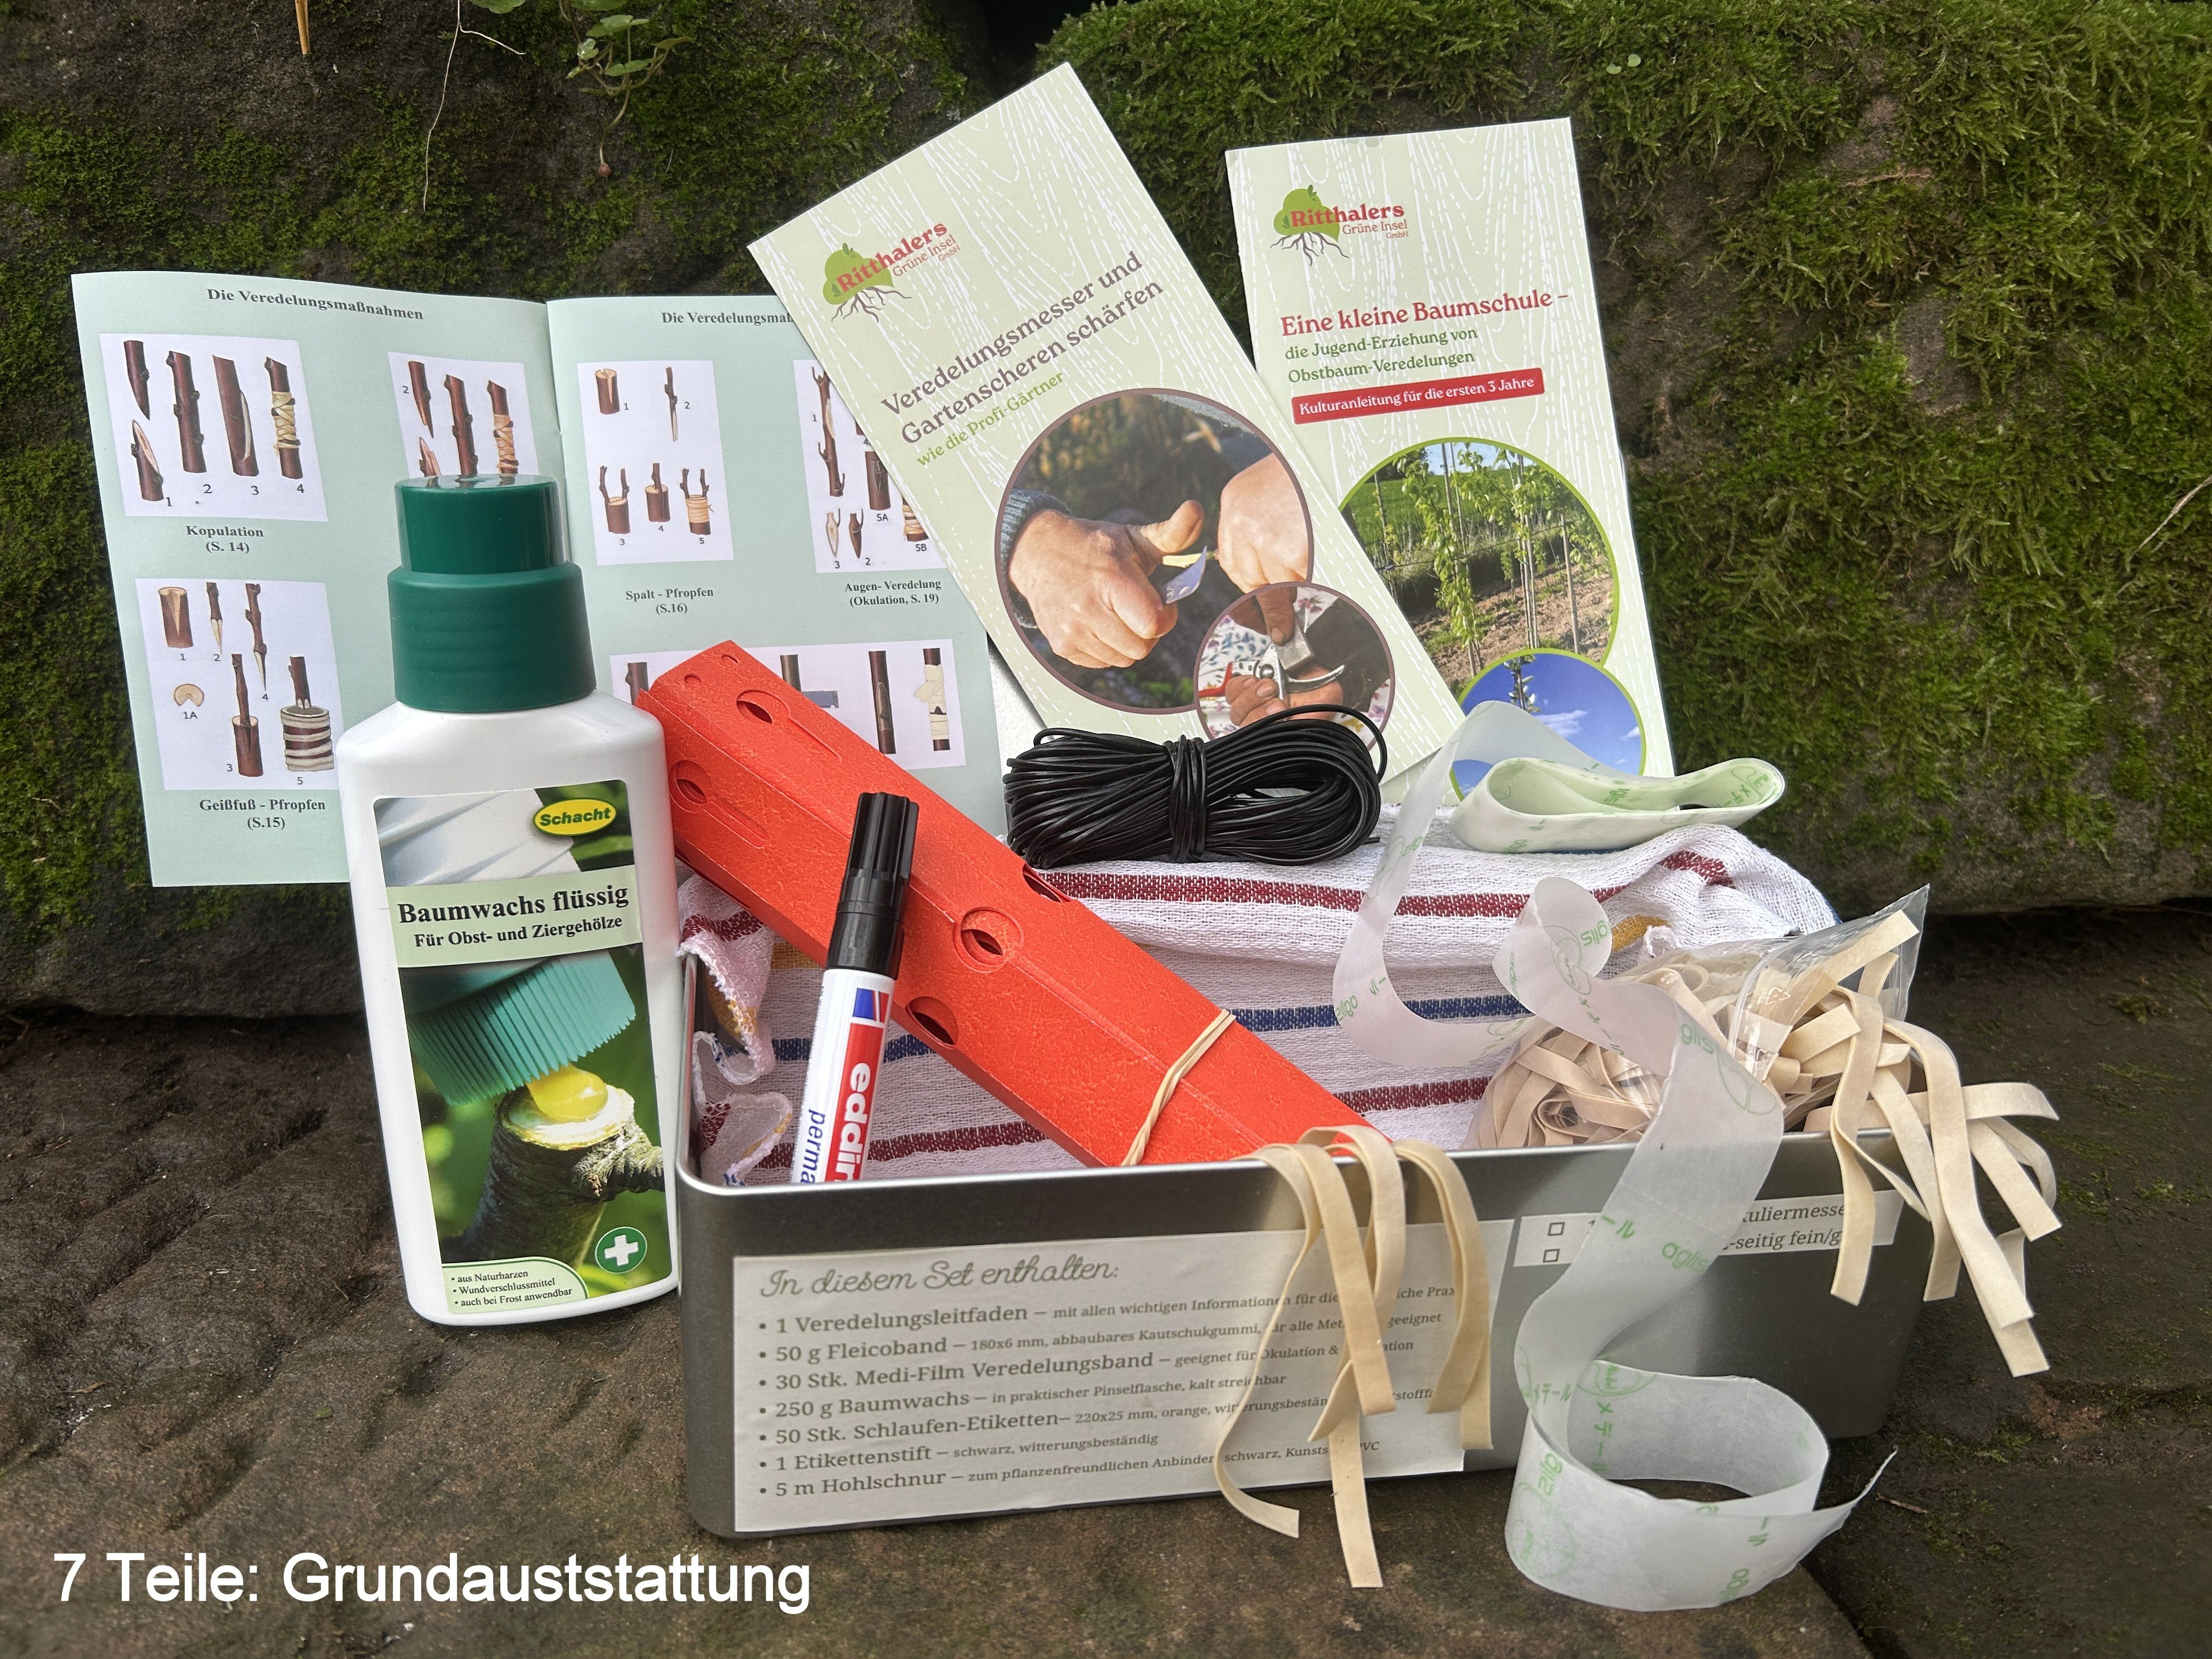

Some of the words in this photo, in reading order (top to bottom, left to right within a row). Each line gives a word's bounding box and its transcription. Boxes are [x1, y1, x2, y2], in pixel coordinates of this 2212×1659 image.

[1290, 204, 1404, 227] Ritthalers
[1342, 222, 1378, 235] Grüne
[1381, 219, 1408, 231] Insel
[1386, 231, 1408, 239] GmbH
[836, 223, 947, 293] Ritthalers
[892, 253, 928, 277] Grüne
[929, 234, 956, 257] Insel
[938, 245, 961, 262] GmbH
[207, 289, 234, 301] Die
[239, 290, 424, 320] Veredelungsmaßnahmen
[1280, 314, 1333, 336] Eine
[1339, 307, 1408, 330] kleine
[1413, 289, 1553, 321] Baumschule
[662, 312, 684, 323] Die
[687, 312, 794, 326] Veredelungsma
[881, 281, 1095, 415] Veredelungsmesser
[1098, 251, 1142, 289] und
[1285, 346, 1308, 360] die
[1311, 331, 1448, 359] Jugend-Erziehung
[1450, 328, 1478, 342] von
[901, 341, 1066, 443] Gartenscheren
[1067, 281, 1164, 347] schärfen
[1288, 351, 1475, 383] Obstbaum-Veredelungen
[1299, 391, 1402, 416] Kulturanleitung
[1403, 389, 1422, 404] für
[1424, 387, 1443, 400] die
[1445, 383, 1485, 398] ersten
[1487, 381, 1496, 393] 3
[1498, 375, 1534, 392] Jahre
[916, 445, 945, 467] wie
[945, 430, 968, 452] die
[966, 371, 1064, 437] Profi-Gärtner
[203, 484, 212, 494] 2
[251, 486, 259, 495] 3
[297, 484, 304, 493] 4
[166, 497, 172, 506] 1
[877, 514, 888, 522] 5A
[186, 525, 264, 538] Kopulation
[206, 541, 224, 553] (S.
[229, 541, 250, 554] 14)
[626, 589, 655, 603] Spalt
[666, 588, 714, 602] Pfropfen
[845, 582, 881, 594] Augen-
[884, 579, 941, 592] Veredelung
[656, 603, 688, 616] (S.16)
[850, 595, 908, 607] (Okulation,
[911, 594, 921, 604] S.
[924, 593, 939, 605] 19)
[183, 712, 198, 720] 1A
[227, 764, 233, 772] 3
[297, 777, 303, 785] 5
[200, 798, 256, 811] Geißfuß
[269, 799, 325, 812] Pfropfen
[247, 817, 285, 830] (S.15)
[540, 807, 611, 827] Schacht
[397, 895, 546, 924] Baumwachs
[552, 885, 629, 911] flüssig
[413, 932, 444, 947] Für
[448, 929, 493, 945] Obst-
[498, 926, 528, 942] und
[532, 916, 623, 939] Ziergehölze
[800, 1109, 826, 1183] perma
[458, 1275, 473, 1283] aus
[475, 1270, 528, 1283] Naturharzen
[760, 1269, 803, 1297] In
[811, 1268, 918, 1294] diesem
[924, 1260, 974, 1289] Set
[981, 1254, 1118, 1285] enthalten:
[459, 1278, 556, 1295] Wundverschlussmittel
[461, 1297, 481, 1307] auch
[484, 1295, 498, 1306] bei
[499, 1294, 522, 1305] Frost
[524, 1288, 573, 1302] anwendbar
[776, 1318, 787, 1333] 1
[795, 1305, 1028, 1333] Veredelungsleitfaden
[1053, 1306, 1077, 1318] mit
[1081, 1305, 1116, 1317] allen
[1120, 1300, 1187, 1316] wichtigen
[1295, 1293, 1317, 1305] für
[1319, 1291, 1339, 1304] die
[776, 1346, 802, 1362] 50
[808, 1347, 821, 1365] g
[828, 1337, 947, 1359] Fleicoband
[972, 1338, 1013, 1351] 180x6
[1017, 1337, 1048, 1349] mm,
[1052, 1331, 1135, 1346] abbaubares
[1138, 1322, 1261, 1341] Kautschukgummi,
[1289, 1319, 1313, 1331] alle
[776, 1374, 801, 1390] 30
[808, 1372, 847, 1389] Stk.
[855, 1365, 965, 1386] Medi-Film
[972, 1352, 1154, 1377] Veredelungsband
[1175, 1352, 1231, 1368] geeignet
[1236, 1350, 1256, 1361] für
[1329, 1345, 1339, 1355] &
[776, 1401, 814, 1418] 250
[820, 1402, 833, 1419] g
[839, 1391, 969, 1414] Baumwachs
[992, 1392, 1006, 1403] in
[1010, 1386, 1090, 1404] praktischer
[1093, 1379, 1185, 1397] Pinselflasche,
[1189, 1378, 1215, 1391] kalt
[776, 1429, 801, 1444] 50
[807, 1426, 847, 1442] Stk.
[1075, 1410, 1124, 1424] 220x25
[1127, 1408, 1158, 1420] mm,
[1161, 1406, 1210, 1419] orange,
[776, 1457, 787, 1470] 1
[795, 1446, 931, 1470] Etikettenstift
[953, 1445, 1015, 1458] schwarz,
[1019, 1433, 1159, 1454] witterungsbeständig
[776, 1482, 787, 1497] 5
[794, 1483, 815, 1496] m
[822, 1472, 946, 1493] Hohlschnur
[968, 1471, 998, 1482] zum
[1001, 1457, 1148, 1482] pflanzenfreundlichen
[1224, 1449, 1281, 1463] schwarz,
